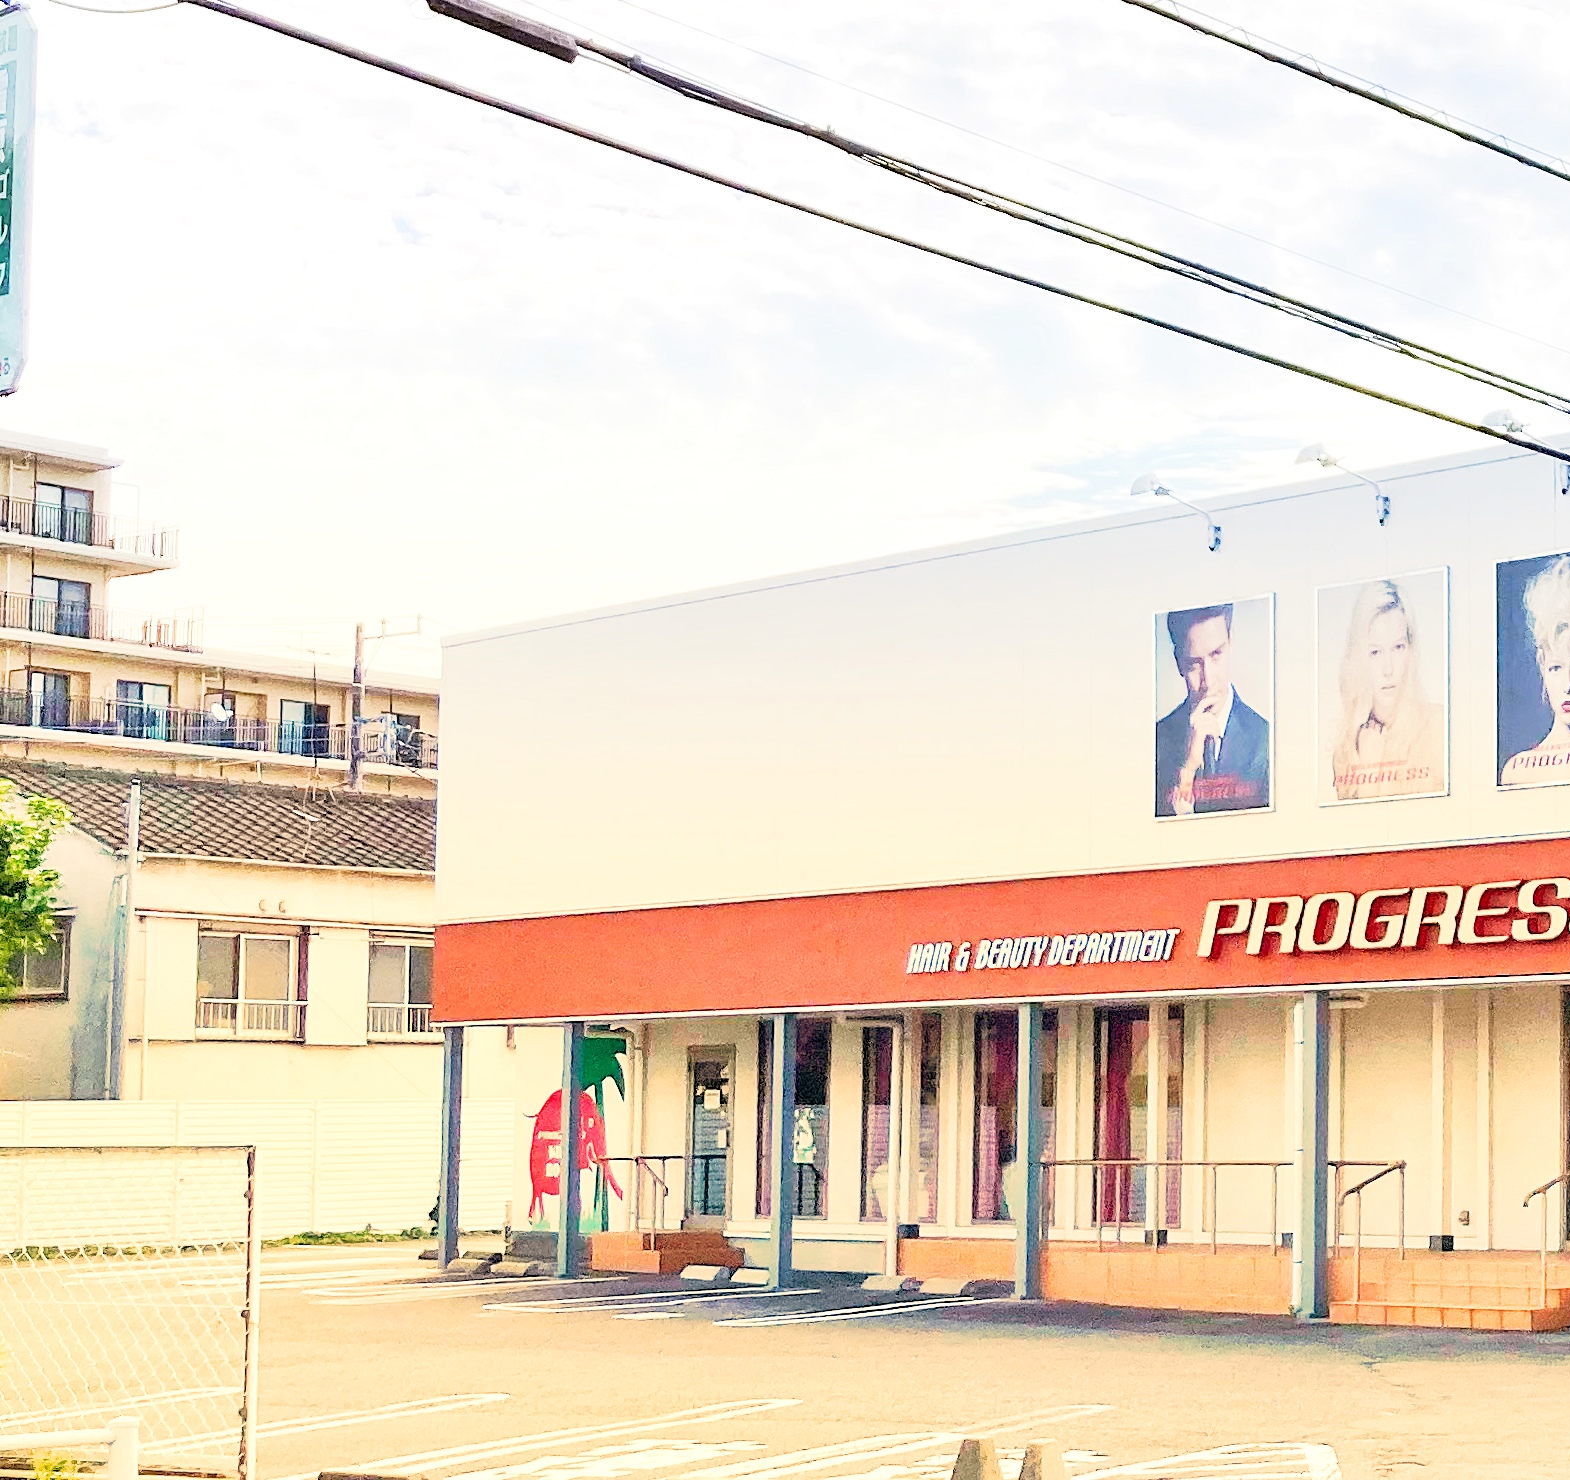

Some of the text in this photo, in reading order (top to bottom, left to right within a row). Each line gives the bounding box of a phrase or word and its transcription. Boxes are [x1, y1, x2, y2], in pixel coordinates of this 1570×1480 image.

[907, 928, 1180, 975] HAIR & BEAUTY DEPARTMENT
